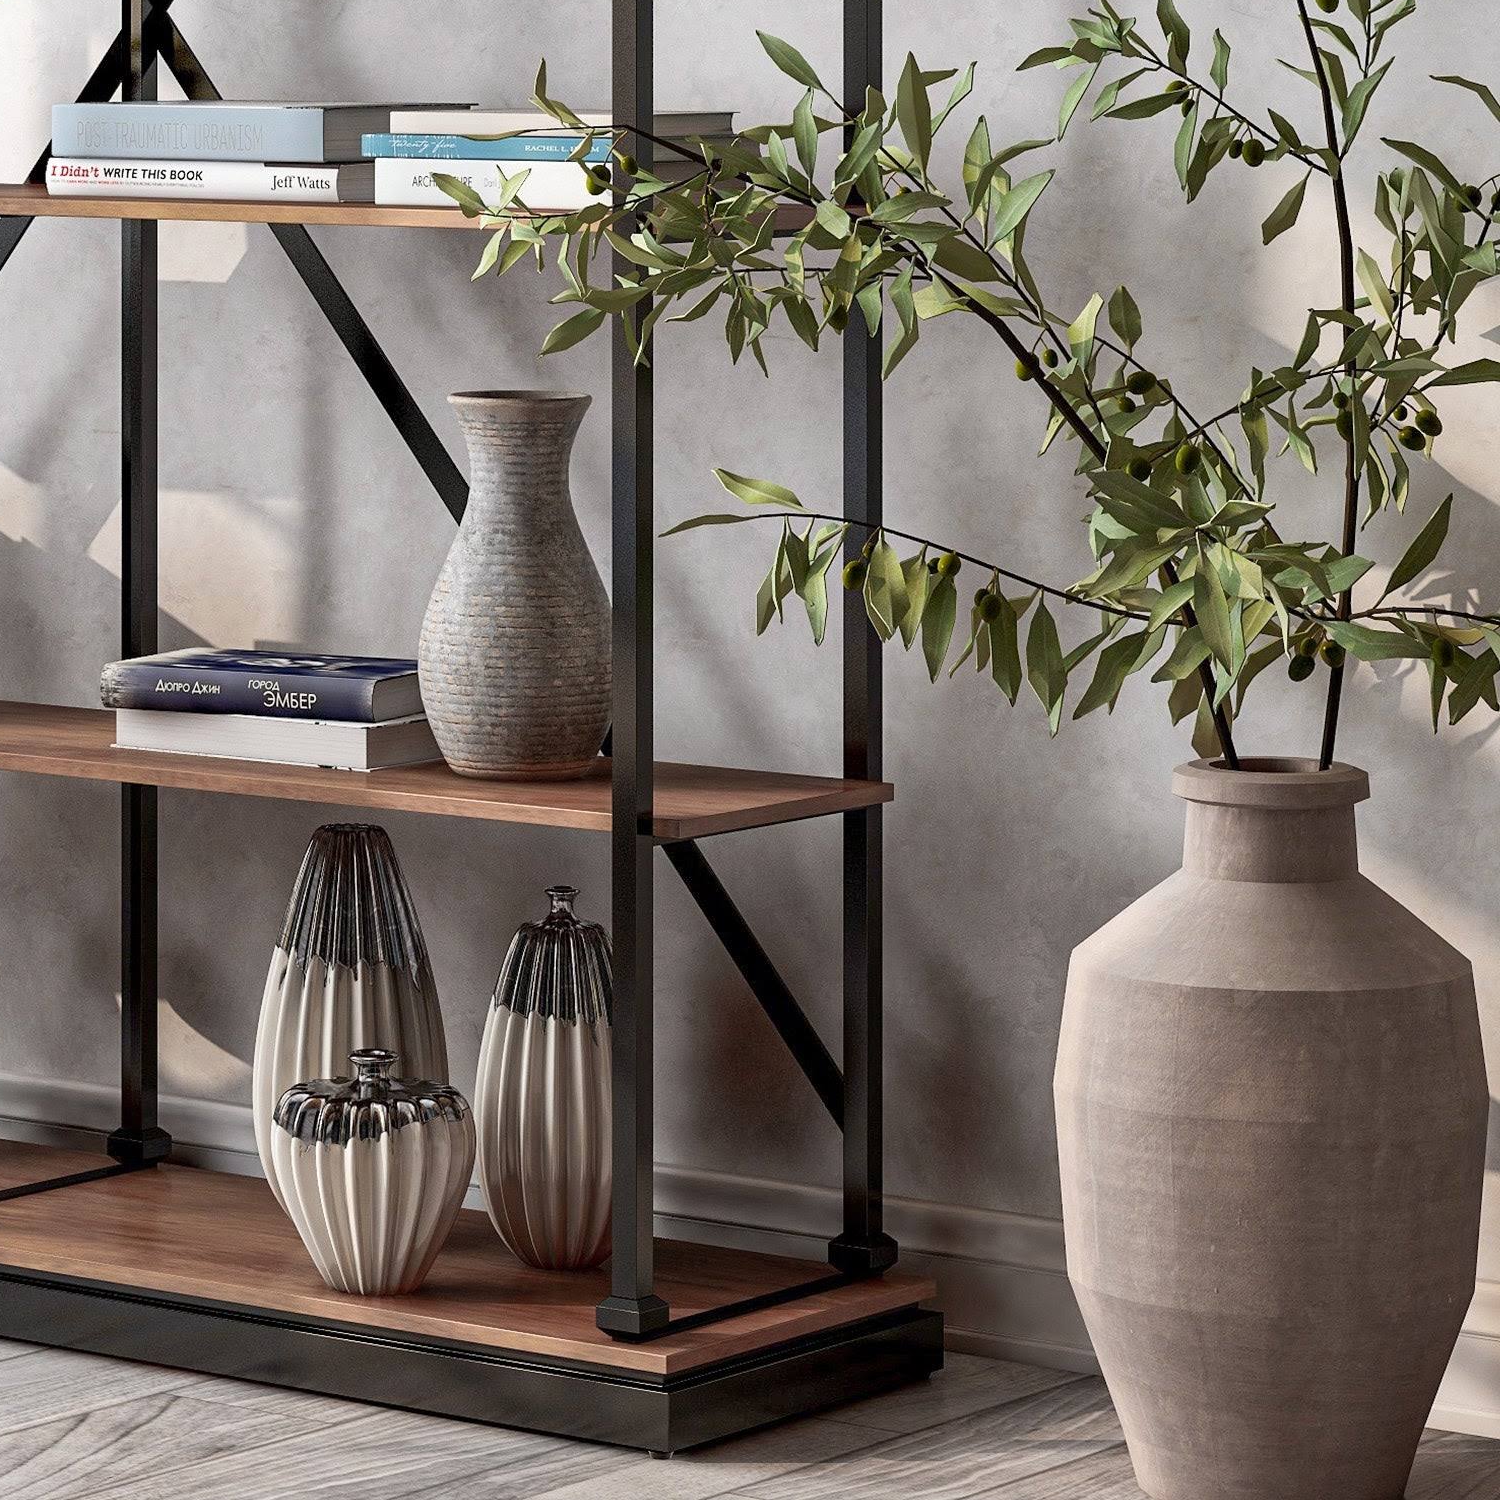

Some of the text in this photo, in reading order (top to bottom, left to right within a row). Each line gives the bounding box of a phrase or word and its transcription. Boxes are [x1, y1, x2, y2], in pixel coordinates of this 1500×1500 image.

[194, 122, 263, 152] URBANISM
[525, 145, 559, 153] RACHEL
[51, 165, 203, 181] I Didn't WRITE THIS BOOK
[271, 175, 331, 191] Jeff Watts
[248, 679, 280, 691] ГОРОД
[263, 691, 317, 710] ЭМБЕР
